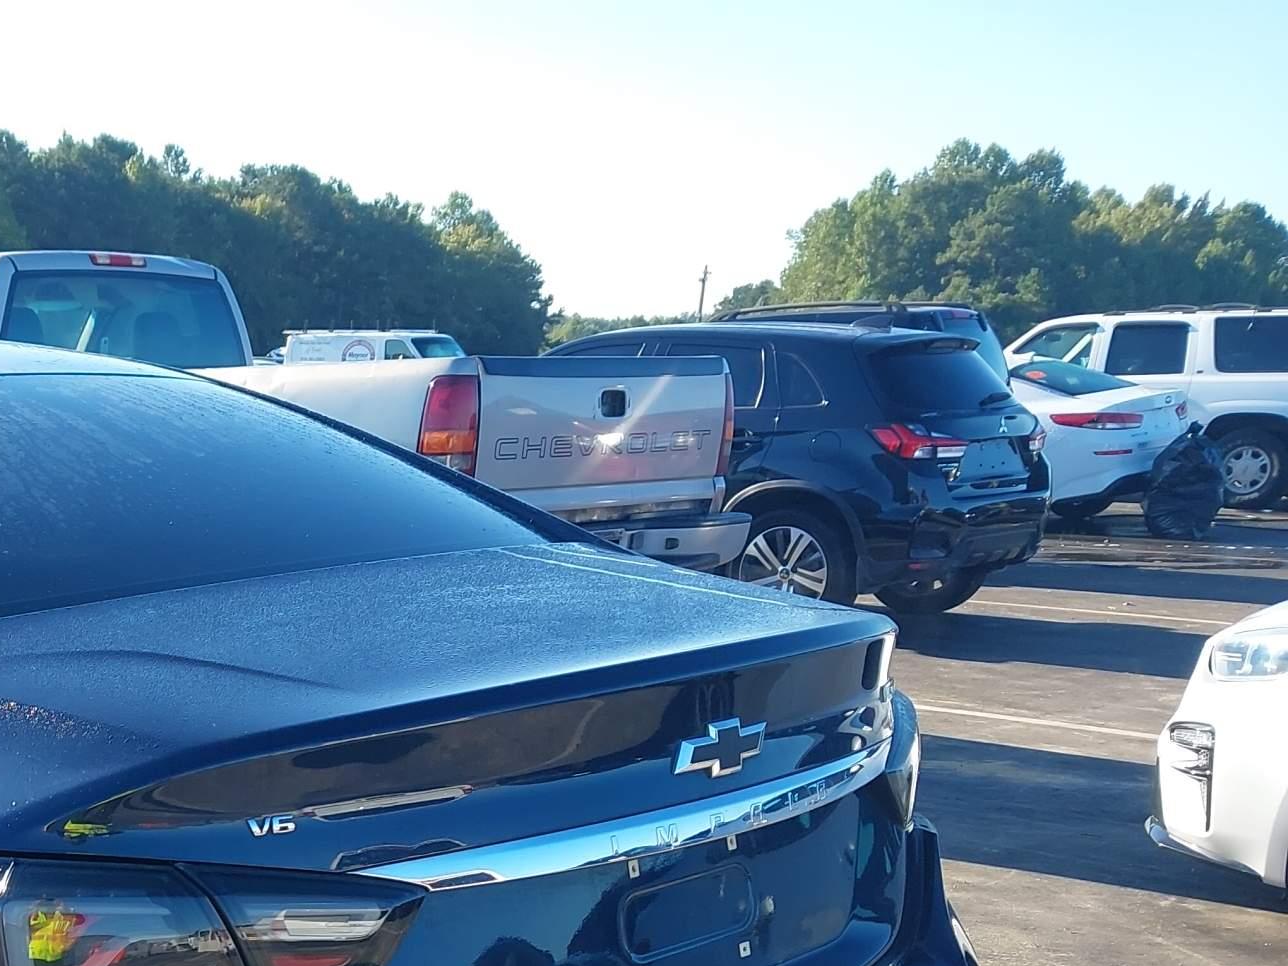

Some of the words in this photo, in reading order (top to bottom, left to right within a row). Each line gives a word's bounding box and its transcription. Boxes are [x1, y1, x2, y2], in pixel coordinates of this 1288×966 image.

[494, 430, 711, 460] CHEVROLET
[247, 815, 296, 837] V6
[610, 779, 827, 857] IMPALA
